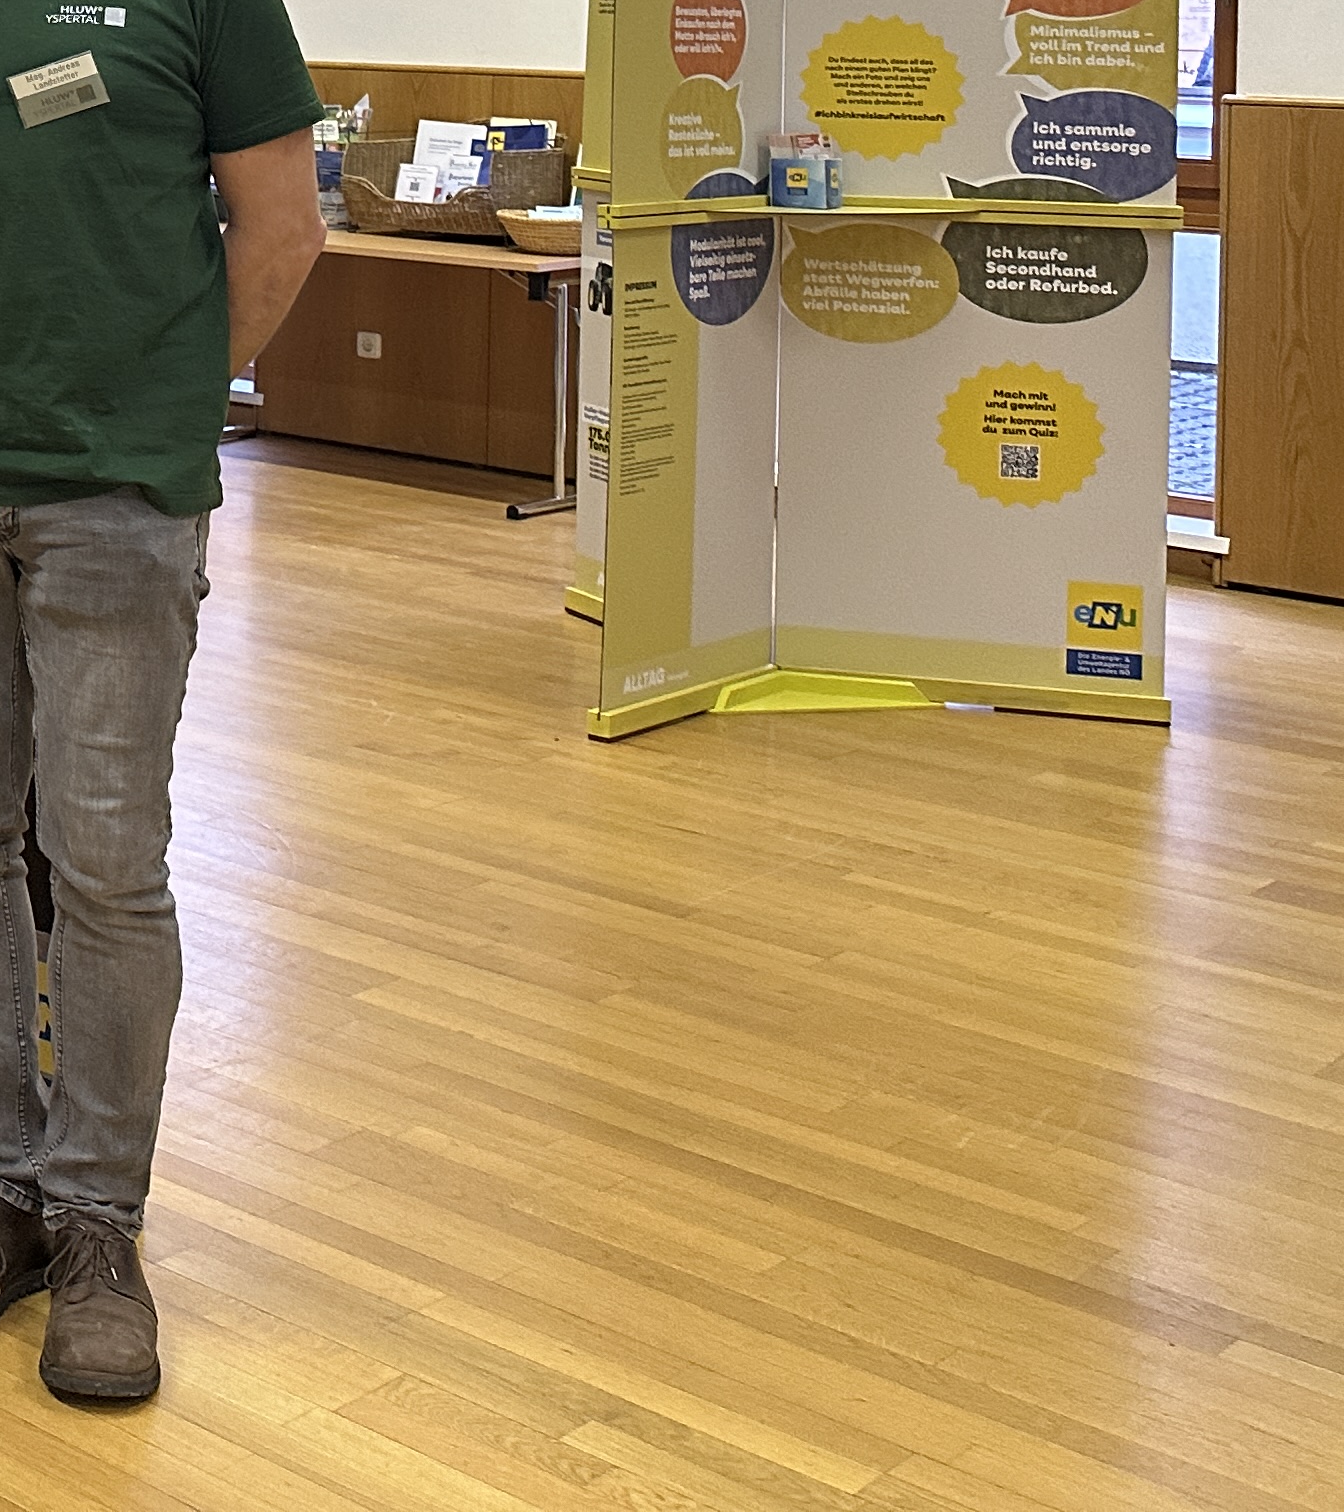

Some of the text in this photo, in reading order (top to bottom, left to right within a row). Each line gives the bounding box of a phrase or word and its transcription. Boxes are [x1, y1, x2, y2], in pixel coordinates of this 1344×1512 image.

[45, 14, 100, 25] YSPERTAL
[1029, 25, 1140, 38] Minimalismus
[1029, 39, 1165, 53] voll im Trend und
[1029, 54, 1136, 67] ich bin dabei.
[815, 110, 946, 122] #ichbinkreislaufwirtschaft
[1032, 121, 1136, 138] Ich sammle
[1032, 138, 1152, 156] und entsorge
[1032, 152, 1097, 170] richtig.
[985, 245, 1069, 262] Ich kaufe
[803, 257, 922, 276] Wertschätzung
[985, 260, 1097, 279] Secondhand
[802, 271, 939, 290] statt Wegwerfen:
[985, 277, 1118, 295] oder Refurbed.
[802, 286, 910, 302] Abfälle haben
[802, 299, 911, 316] viel Potenzial.
[993, 389, 1049, 401] Mach mit
[985, 400, 1057, 412] und gewinn!
[983, 414, 1058, 427] Hier kommst
[982, 424, 1059, 438] du zum Quiz:
